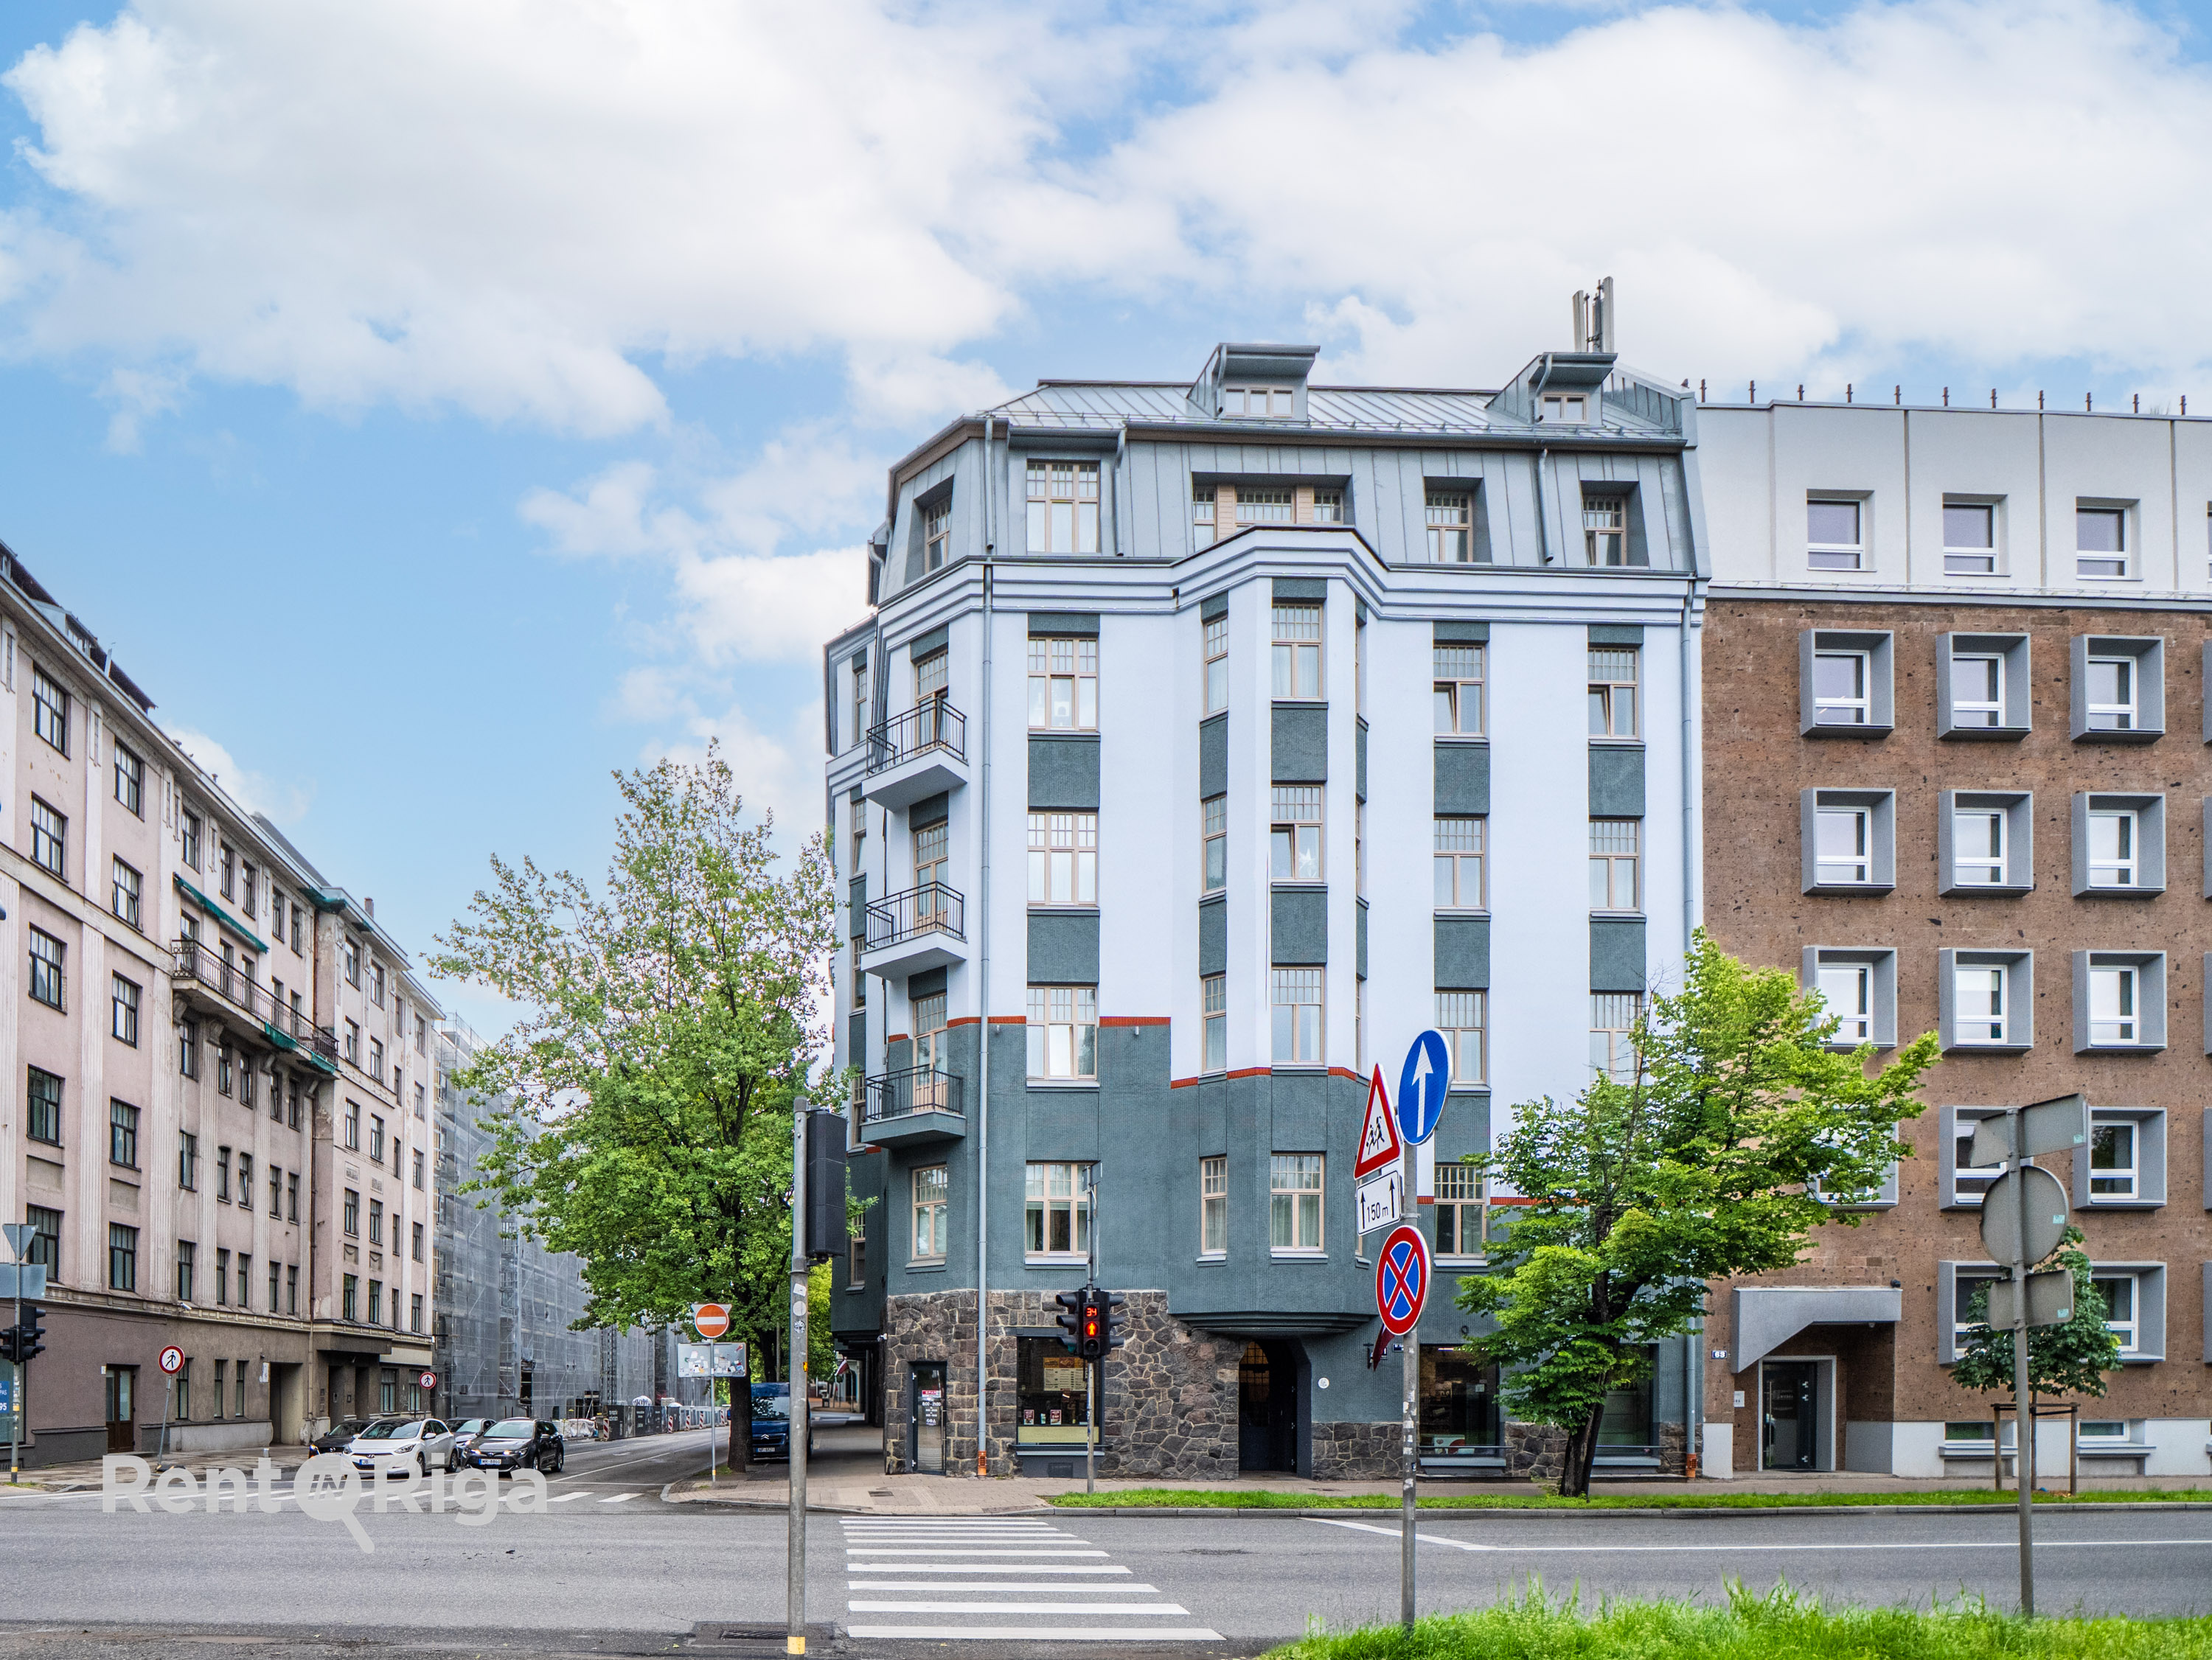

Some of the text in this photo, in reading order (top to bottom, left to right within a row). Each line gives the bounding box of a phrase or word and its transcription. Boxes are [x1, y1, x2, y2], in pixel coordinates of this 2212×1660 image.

[1367, 1202, 1388, 1222] 150 m
[1086, 1308, 1097, 1317] 34
